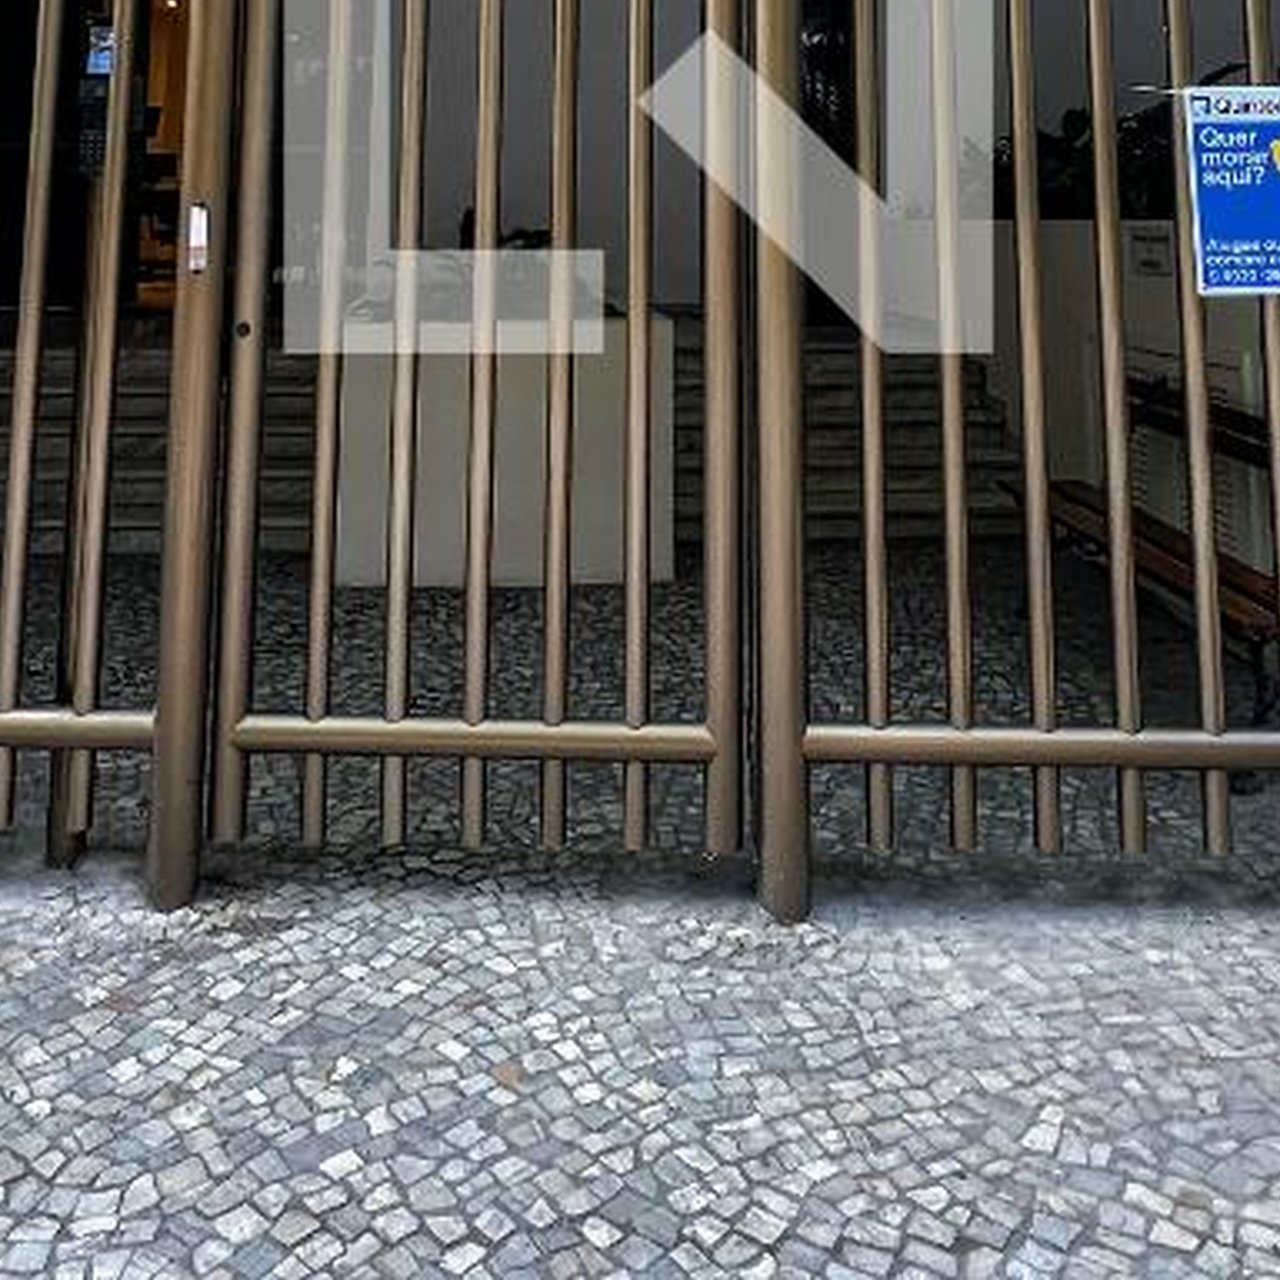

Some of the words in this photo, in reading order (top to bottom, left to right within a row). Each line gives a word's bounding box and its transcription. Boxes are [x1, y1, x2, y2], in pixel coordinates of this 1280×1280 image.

[1199, 126, 1258, 148] Quer
[1201, 150, 1270, 167] morar
[1202, 166, 1265, 190] aqui?
